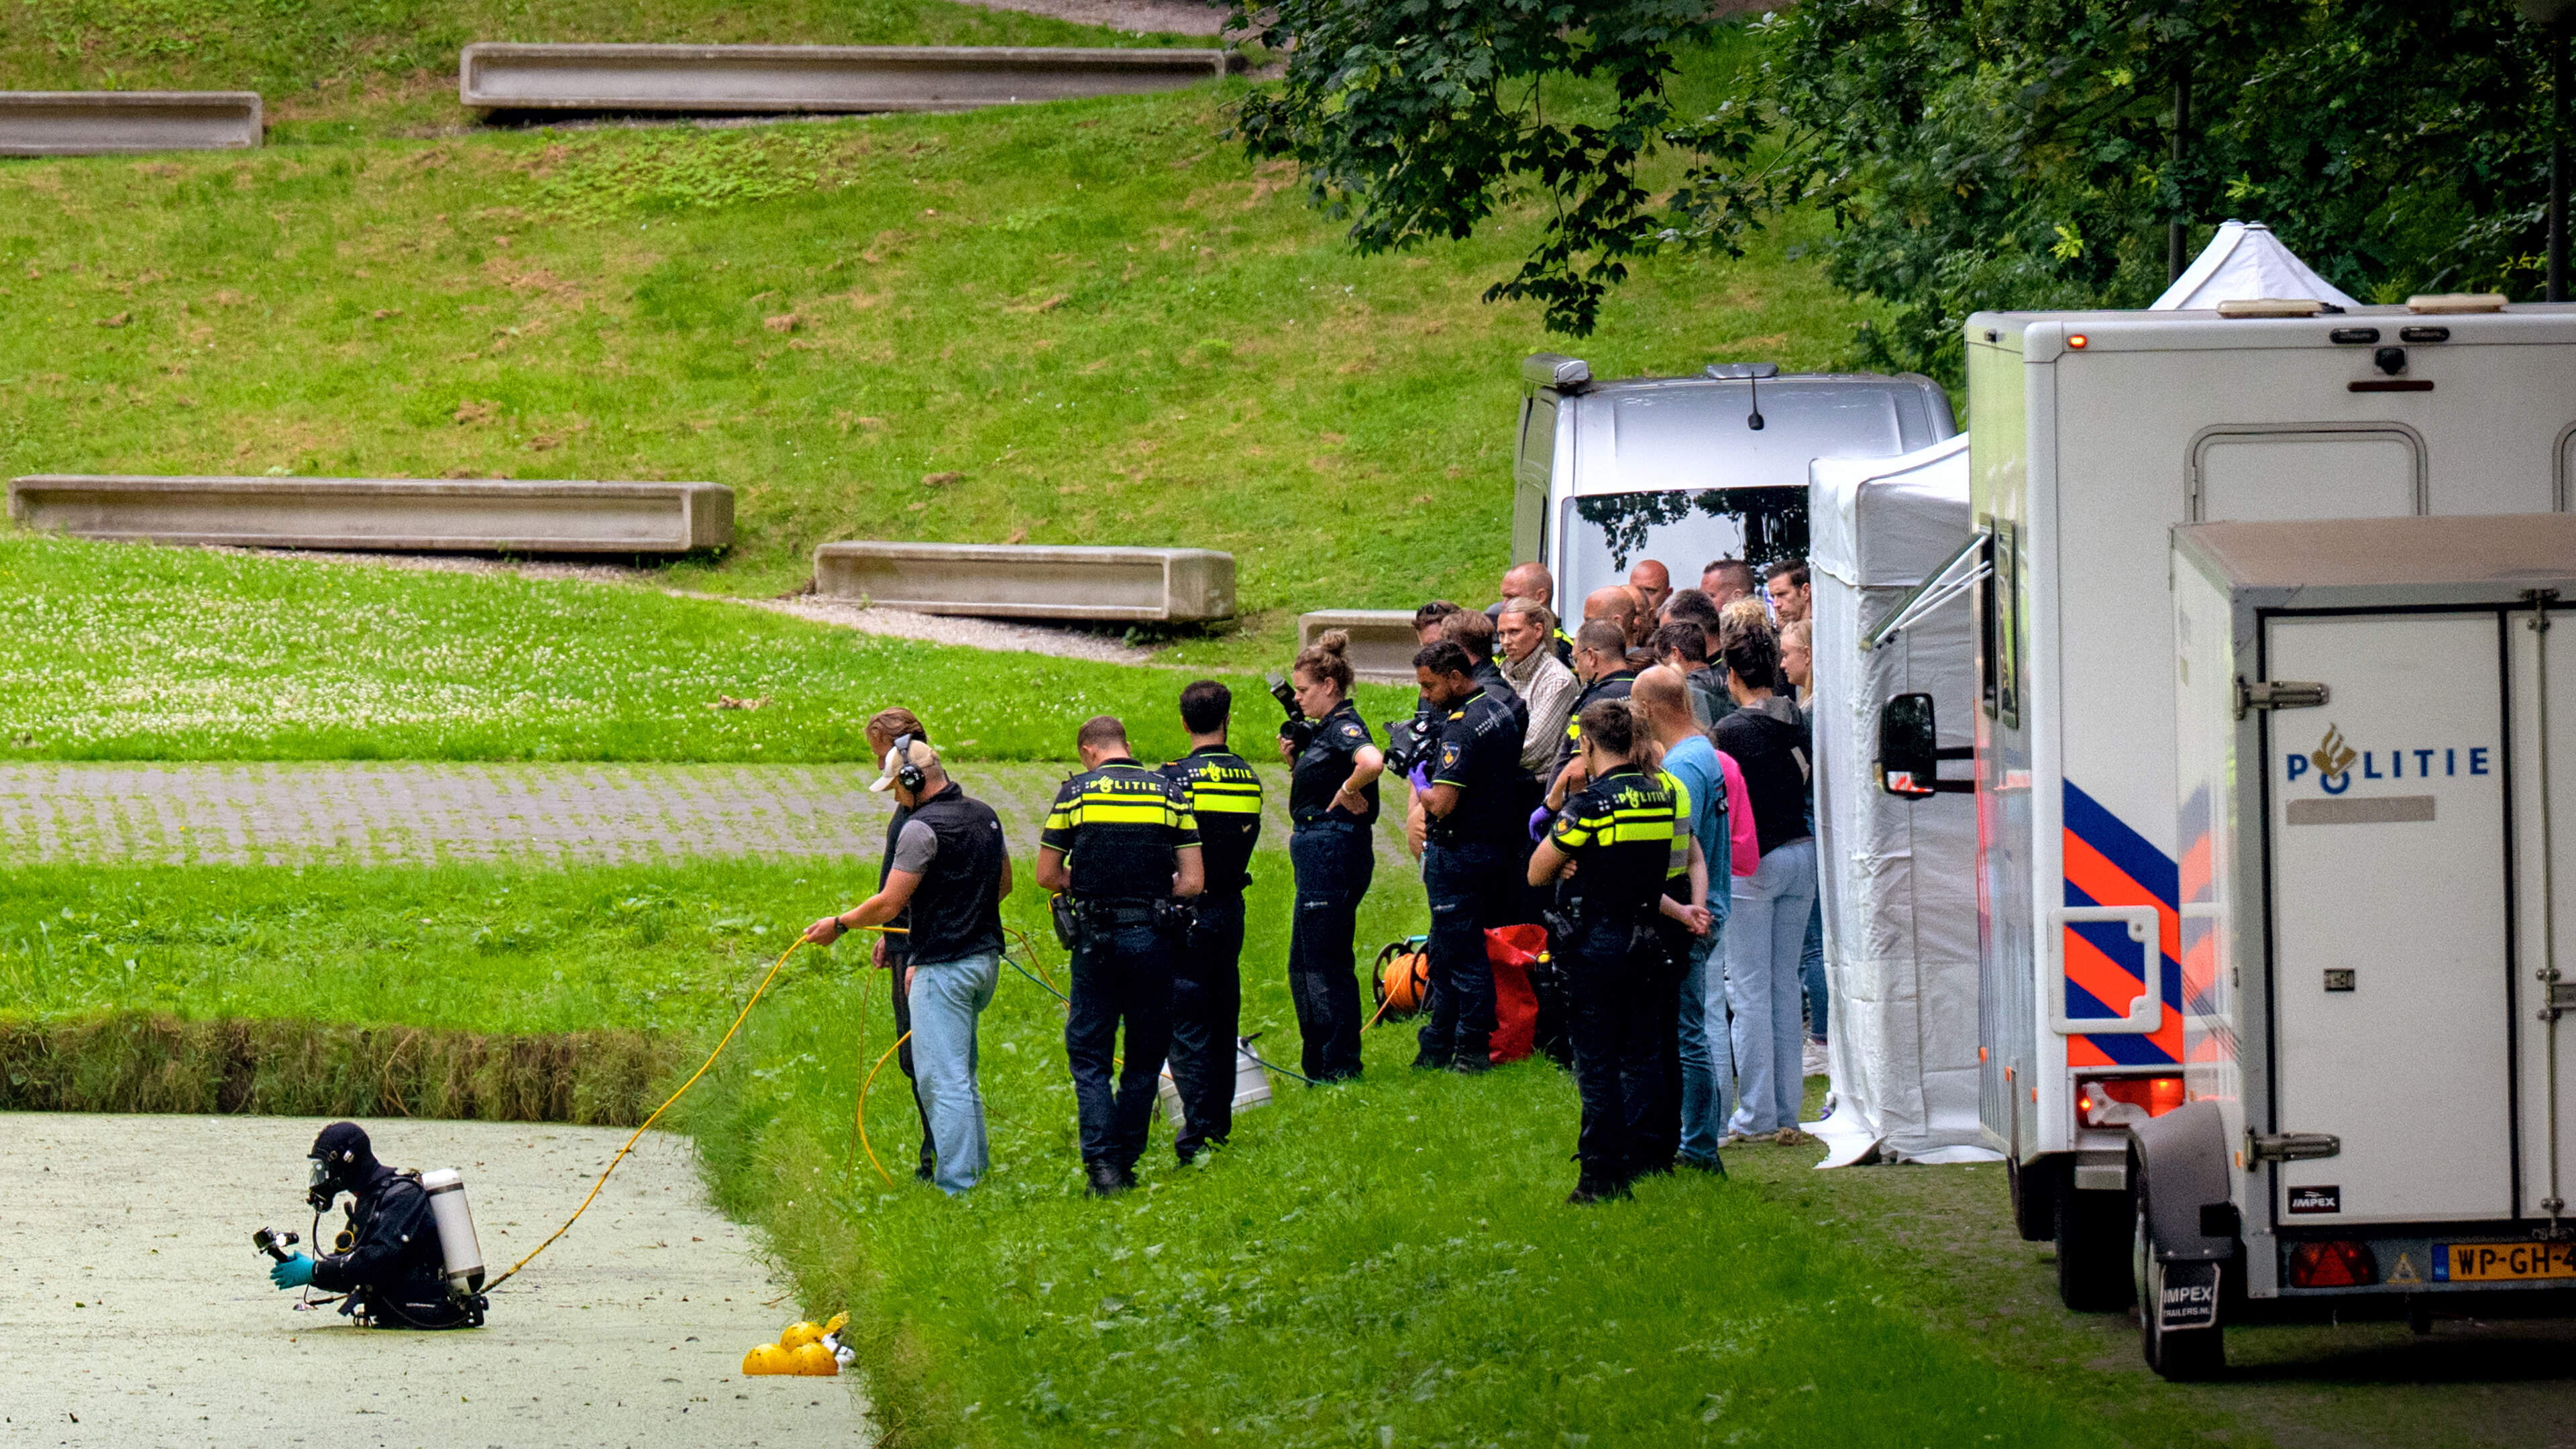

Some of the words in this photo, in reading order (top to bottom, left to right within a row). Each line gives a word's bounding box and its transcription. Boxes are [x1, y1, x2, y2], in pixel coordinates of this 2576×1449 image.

[1197, 766, 1252, 782] POLITIE
[2287, 747, 2489, 795] POLITIE
[1089, 779, 1157, 794] POLITIE
[2292, 1197, 2336, 1208] IMPEX
[2163, 1286, 2212, 1303] IMPEX
